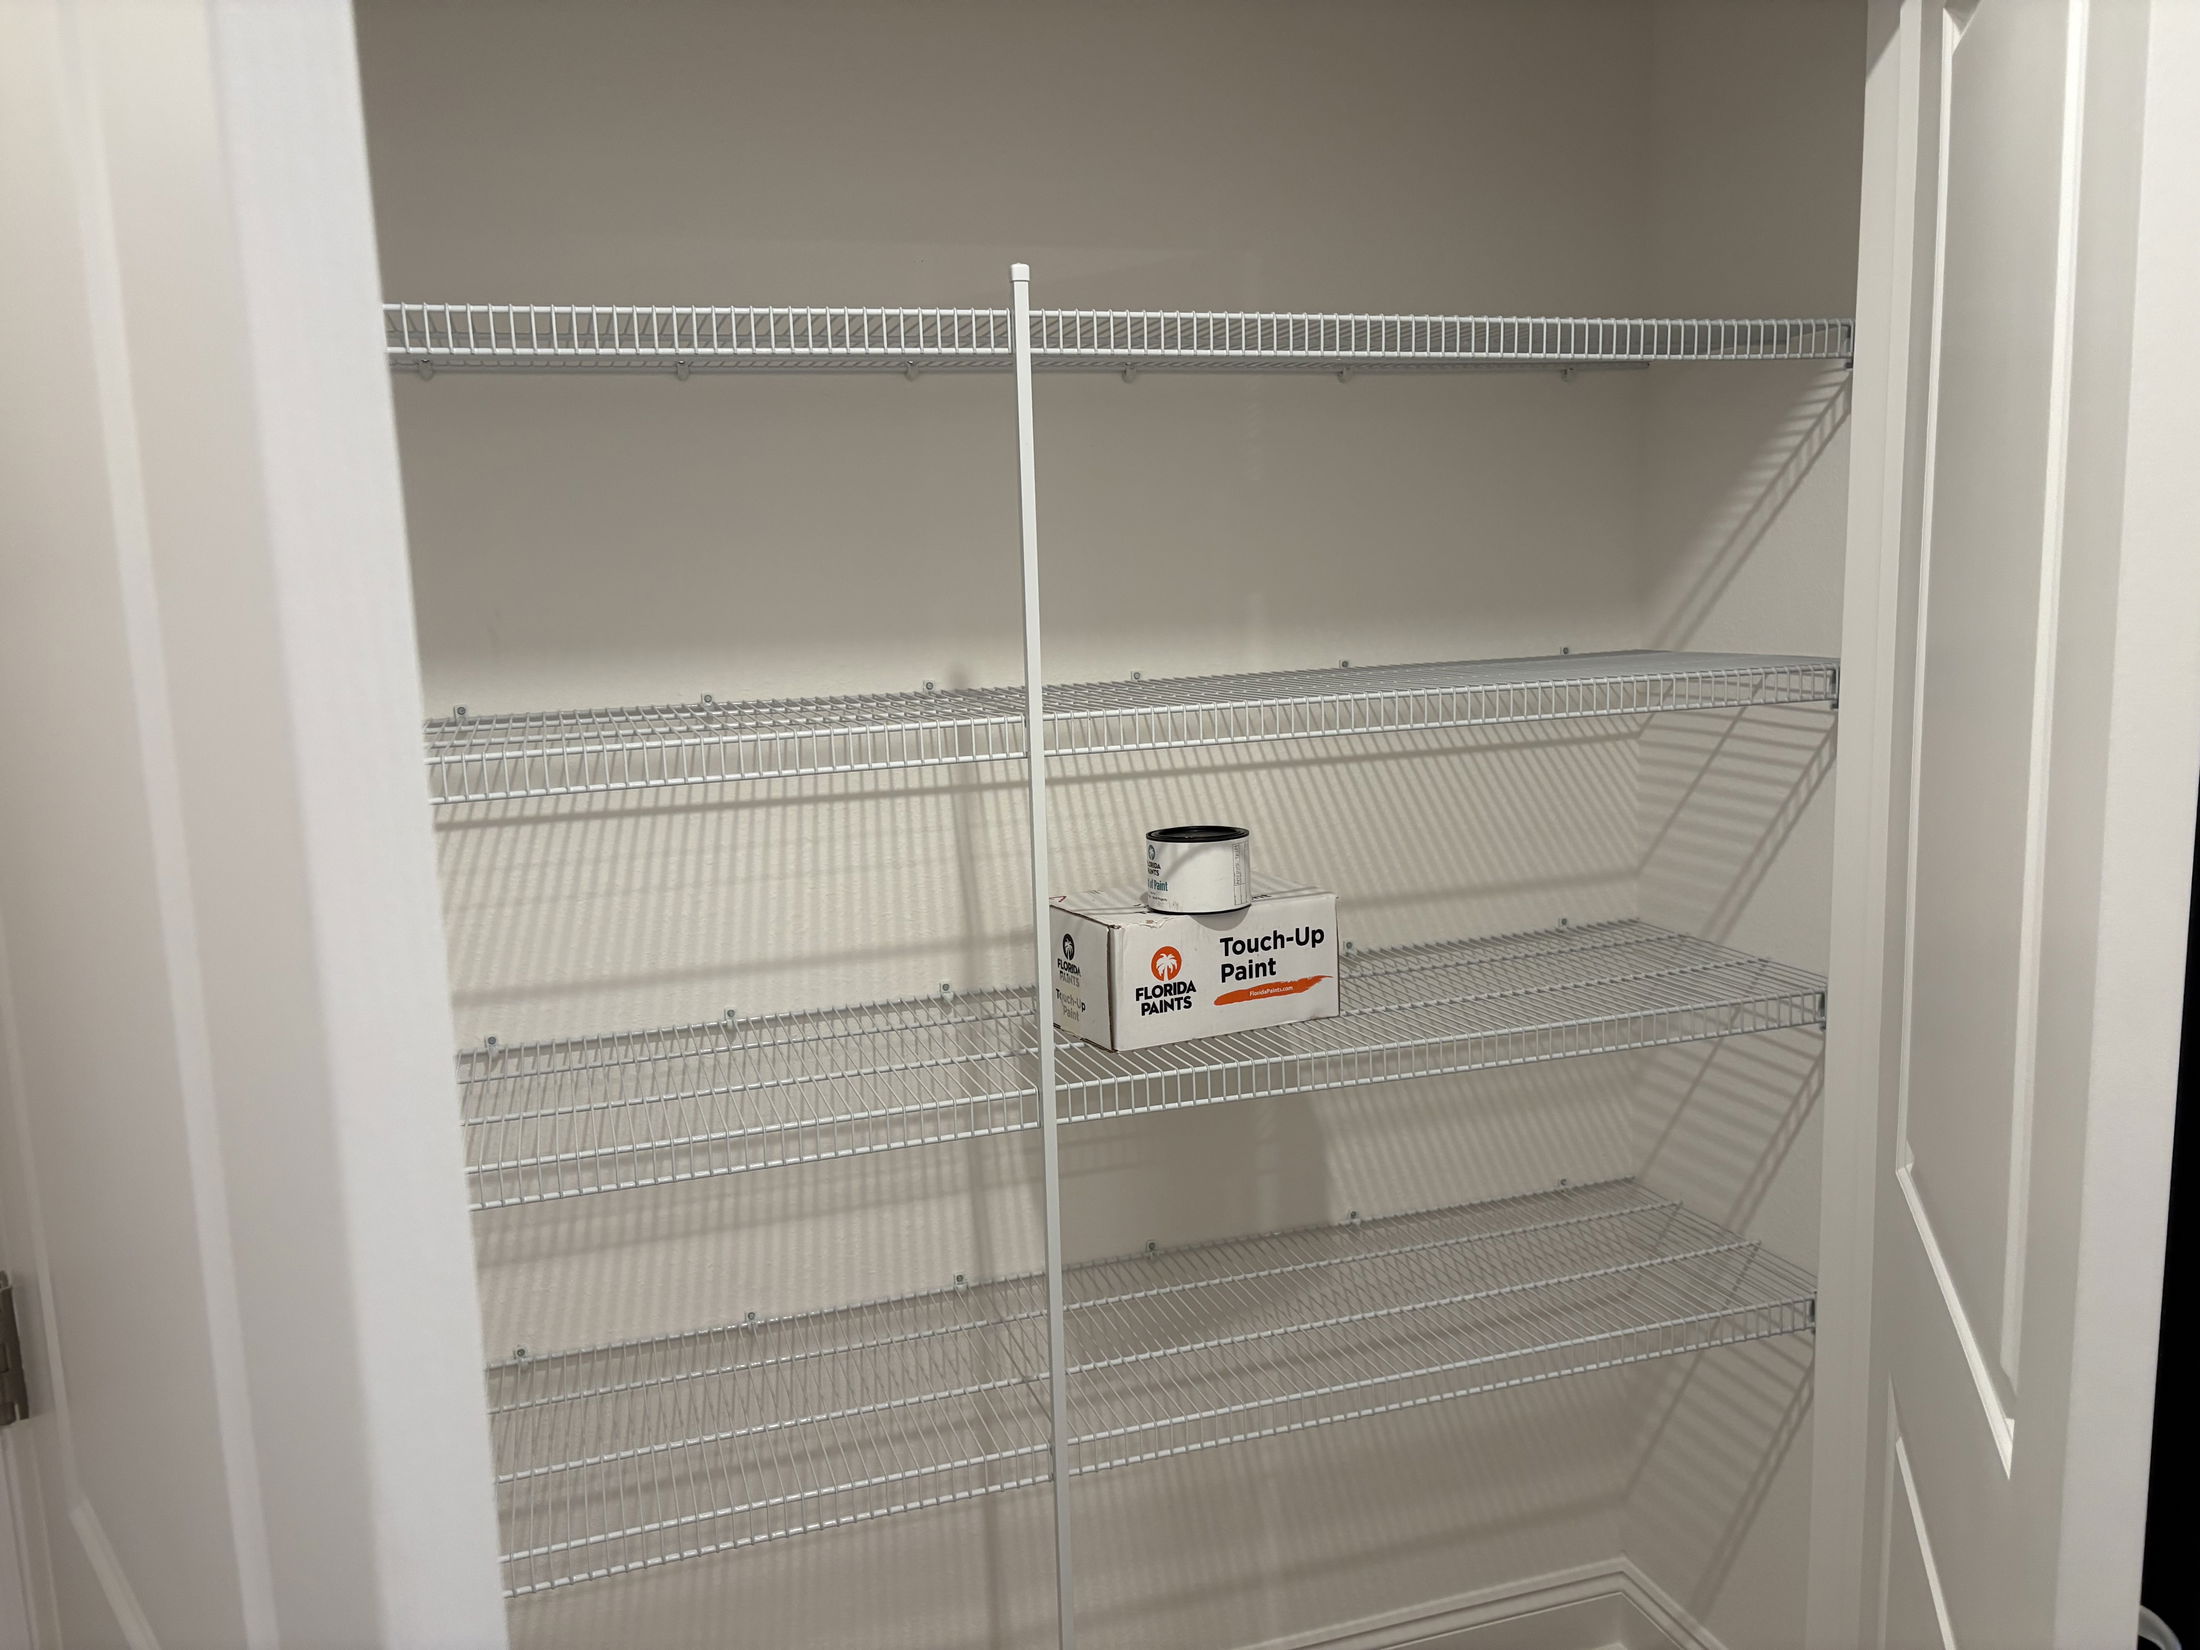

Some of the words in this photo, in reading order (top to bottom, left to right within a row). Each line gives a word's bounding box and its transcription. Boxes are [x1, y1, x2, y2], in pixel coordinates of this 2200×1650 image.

[1154, 880, 1168, 891] Paint
[1220, 926, 1324, 957] Touch-Up
[1057, 959, 1082, 977] FLORIDA
[1221, 957, 1277, 983] Paint
[1059, 971, 1080, 988] PAINTS
[1136, 979, 1197, 1001] FLORIDA
[1249, 985, 1293, 996] FloridaPaints.com
[1056, 989, 1086, 1012] Touch-Up
[1141, 995, 1192, 1016] PAINTS
[1063, 1005, 1079, 1021] Paint
